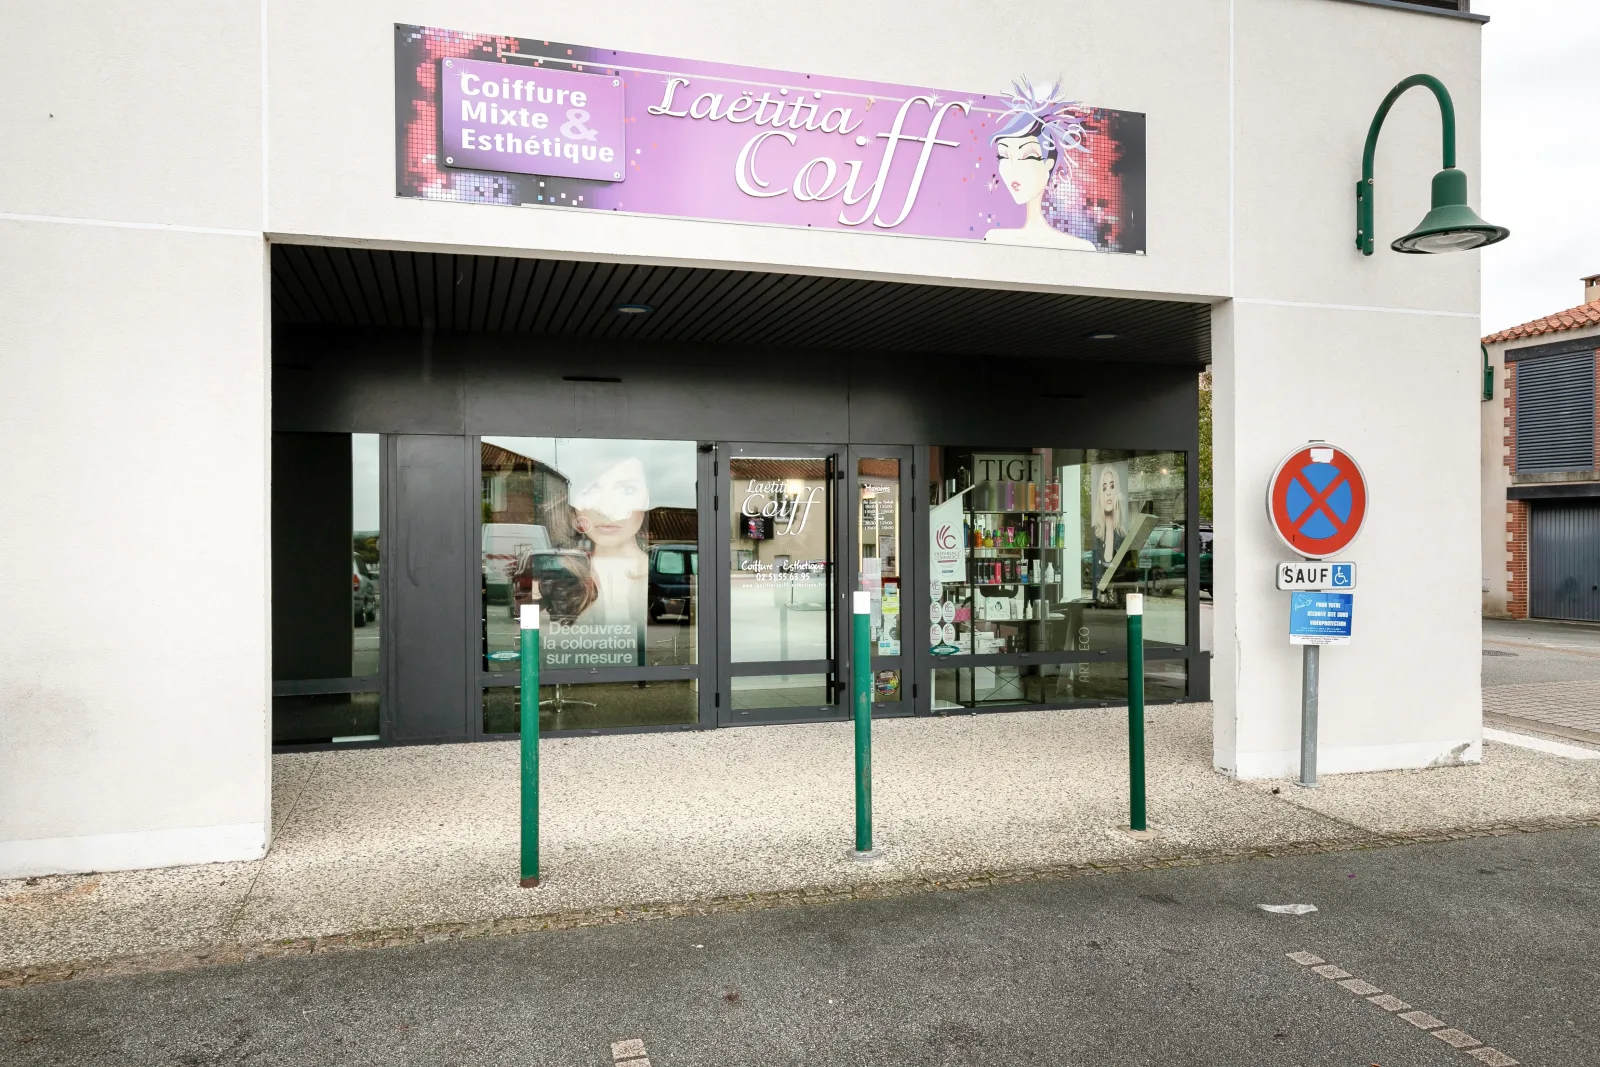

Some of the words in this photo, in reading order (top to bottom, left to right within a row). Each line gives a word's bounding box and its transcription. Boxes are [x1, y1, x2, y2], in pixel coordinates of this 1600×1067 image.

[460, 73, 587, 107] Coiffure
[648, 78, 864, 134] Laëtitia
[461, 100, 549, 129] Mixte
[559, 108, 599, 142] &
[461, 129, 615, 163] Esthétique
[735, 96, 970, 227] Coiff
[979, 459, 1034, 481] TIGI
[745, 479, 796, 493] Laëtit
[742, 486, 824, 535] Coiff
[741, 559, 773, 572] Coiffure
[756, 572, 767, 581] 02
[768, 572, 776, 581] 51
[778, 572, 787, 581] 55
[789, 572, 798, 581] 63
[801, 572, 811, 580] 95
[1284, 568, 1328, 583] SAUF
[549, 621, 632, 635] Découvrez
[543, 636, 557, 650] la
[560, 636, 636, 650] coloration
[546, 653, 572, 664] sur
[575, 653, 633, 664] mesure
